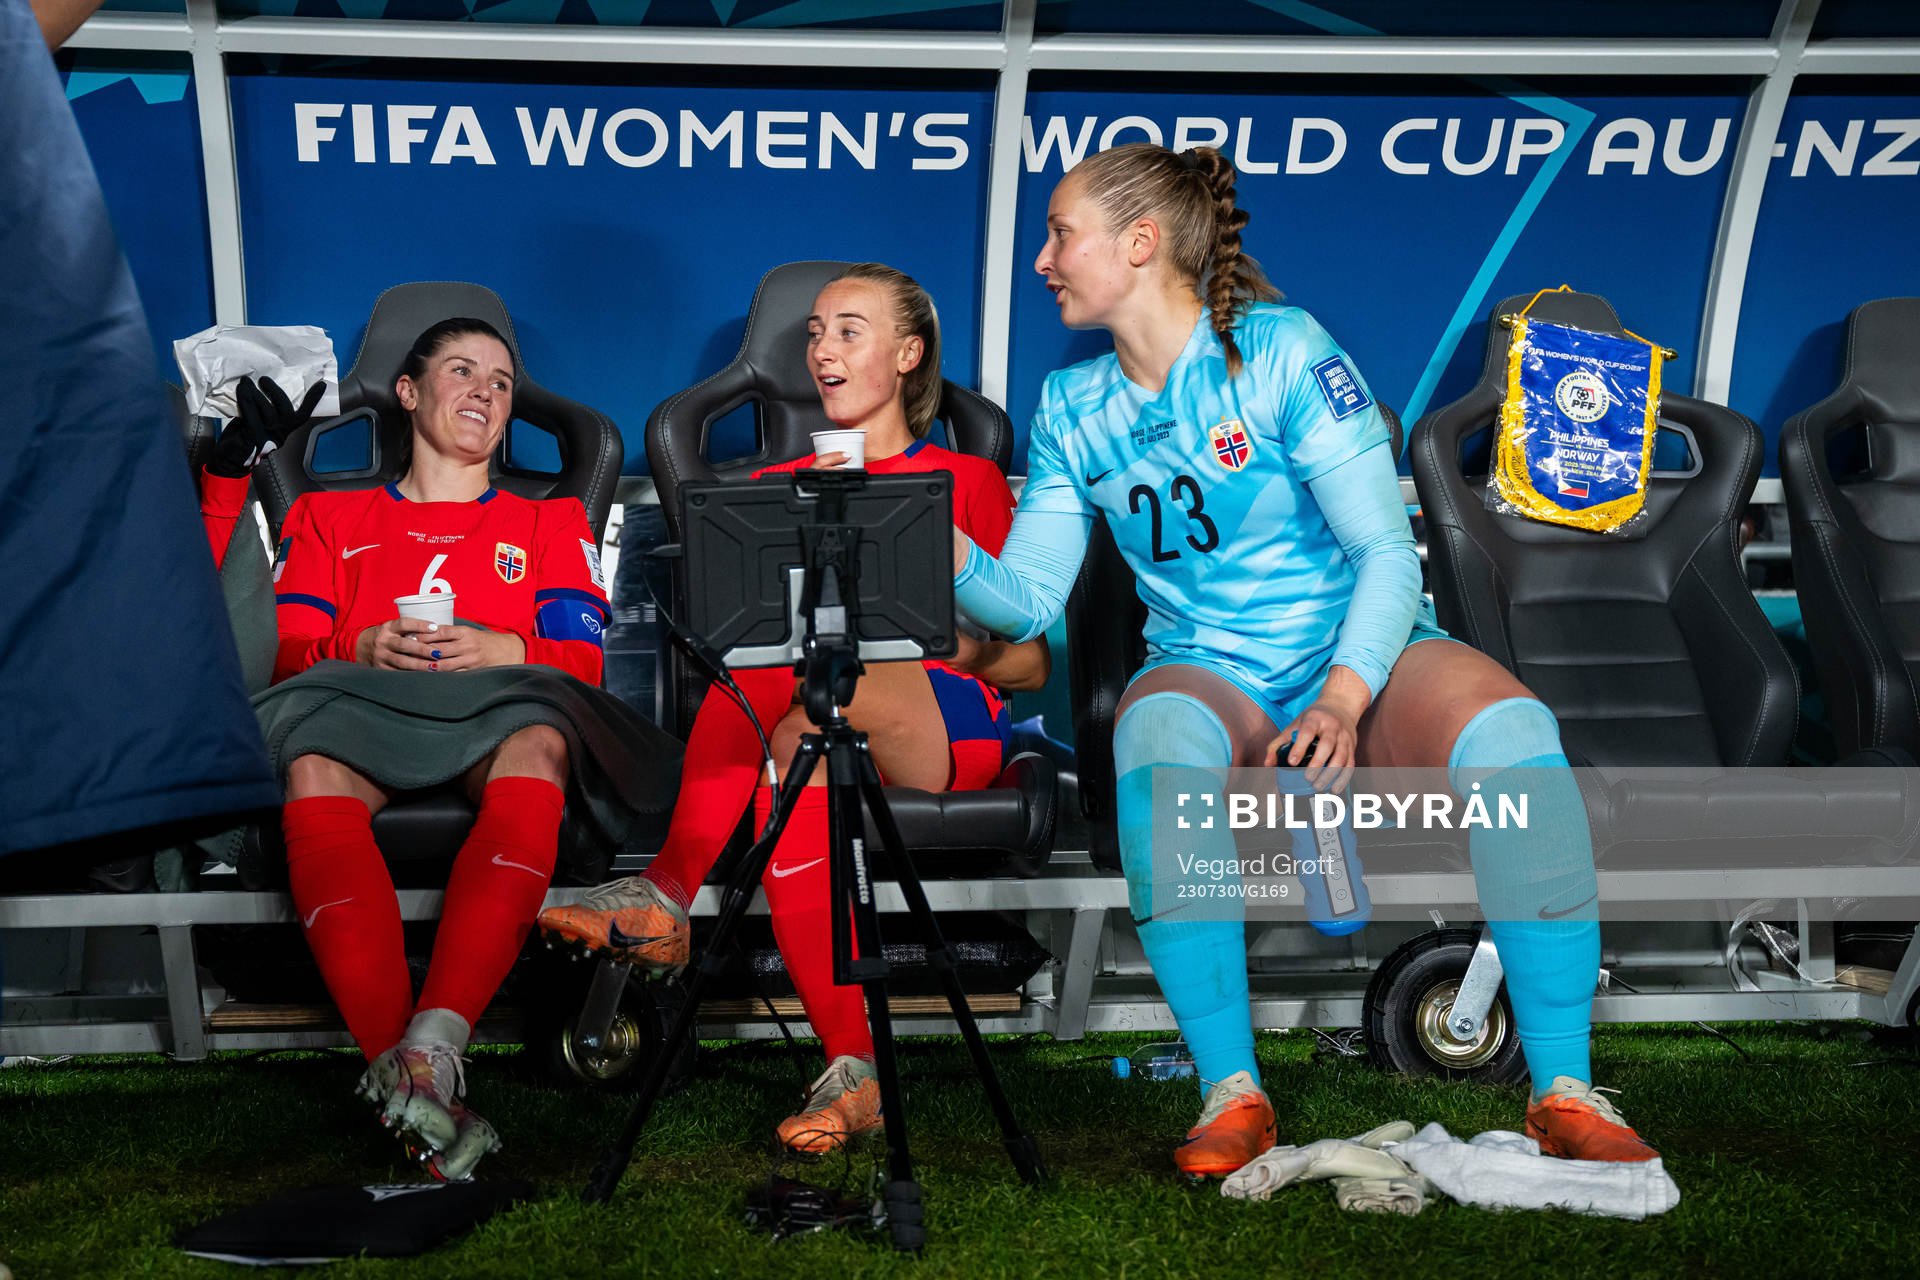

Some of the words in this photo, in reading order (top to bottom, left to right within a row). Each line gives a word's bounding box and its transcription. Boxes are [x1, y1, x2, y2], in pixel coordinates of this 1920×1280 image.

[295, 102, 497, 165] FIFA
[515, 106, 970, 171] WOMEN'S
[1020, 115, 1348, 175] WORLD
[1380, 117, 1565, 176] CUP
[1571, 399, 1597, 411] PFF
[1549, 431, 1609, 448] PHILIPPINES
[1556, 448, 1600, 463] NORWAY
[1128, 474, 1220, 563] 23
[418, 553, 453, 595] 6
[852, 838, 870, 904] Manfrotto
